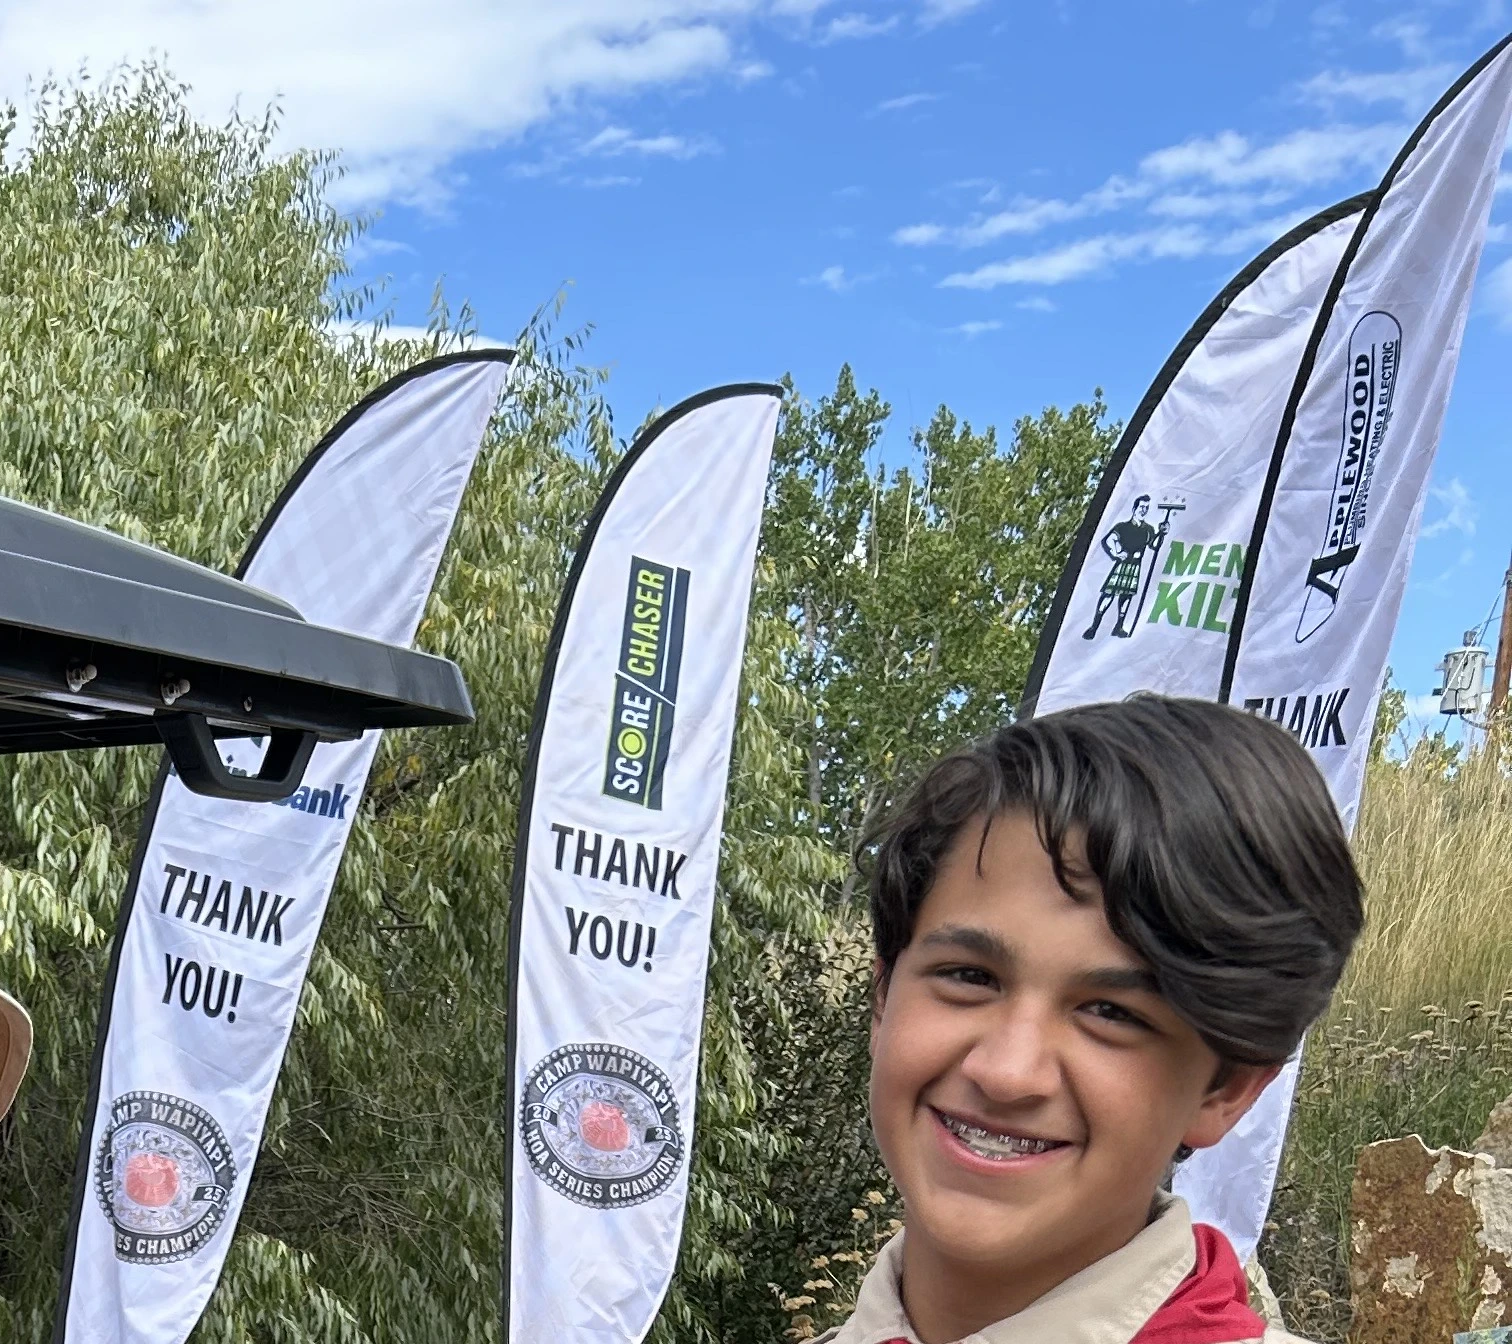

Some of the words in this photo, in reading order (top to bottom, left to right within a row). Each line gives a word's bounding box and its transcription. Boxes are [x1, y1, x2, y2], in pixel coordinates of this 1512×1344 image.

[1378, 340, 1394, 406] ELECTRIC
[1375, 407, 1387, 417] &
[1305, 353, 1370, 605] APPLEWOOD
[626, 568, 666, 677] CHASER
[1147, 581, 1239, 634] KIL
[611, 690, 652, 794] SCORE
[272, 783, 351, 820] ank
[551, 822, 688, 900] THANK
[159, 863, 297, 946] THANK
[565, 906, 657, 973] YOU!
[161, 953, 243, 1024] YOU!
[532, 1107, 552, 1121] 20
[535, 1053, 583, 1094] CAMP
[586, 1054, 672, 1115] WAPIYAPI
[110, 1102, 143, 1128] AMP
[151, 1102, 227, 1173] WAPIYAPI
[526, 1129, 550, 1166] HOA
[548, 1162, 604, 1199] SERIES
[609, 1151, 676, 1198] CHAMPION
[654, 1128, 672, 1141] 25
[203, 1187, 224, 1201] 25
[136, 1211, 217, 1255] CHAMPION
